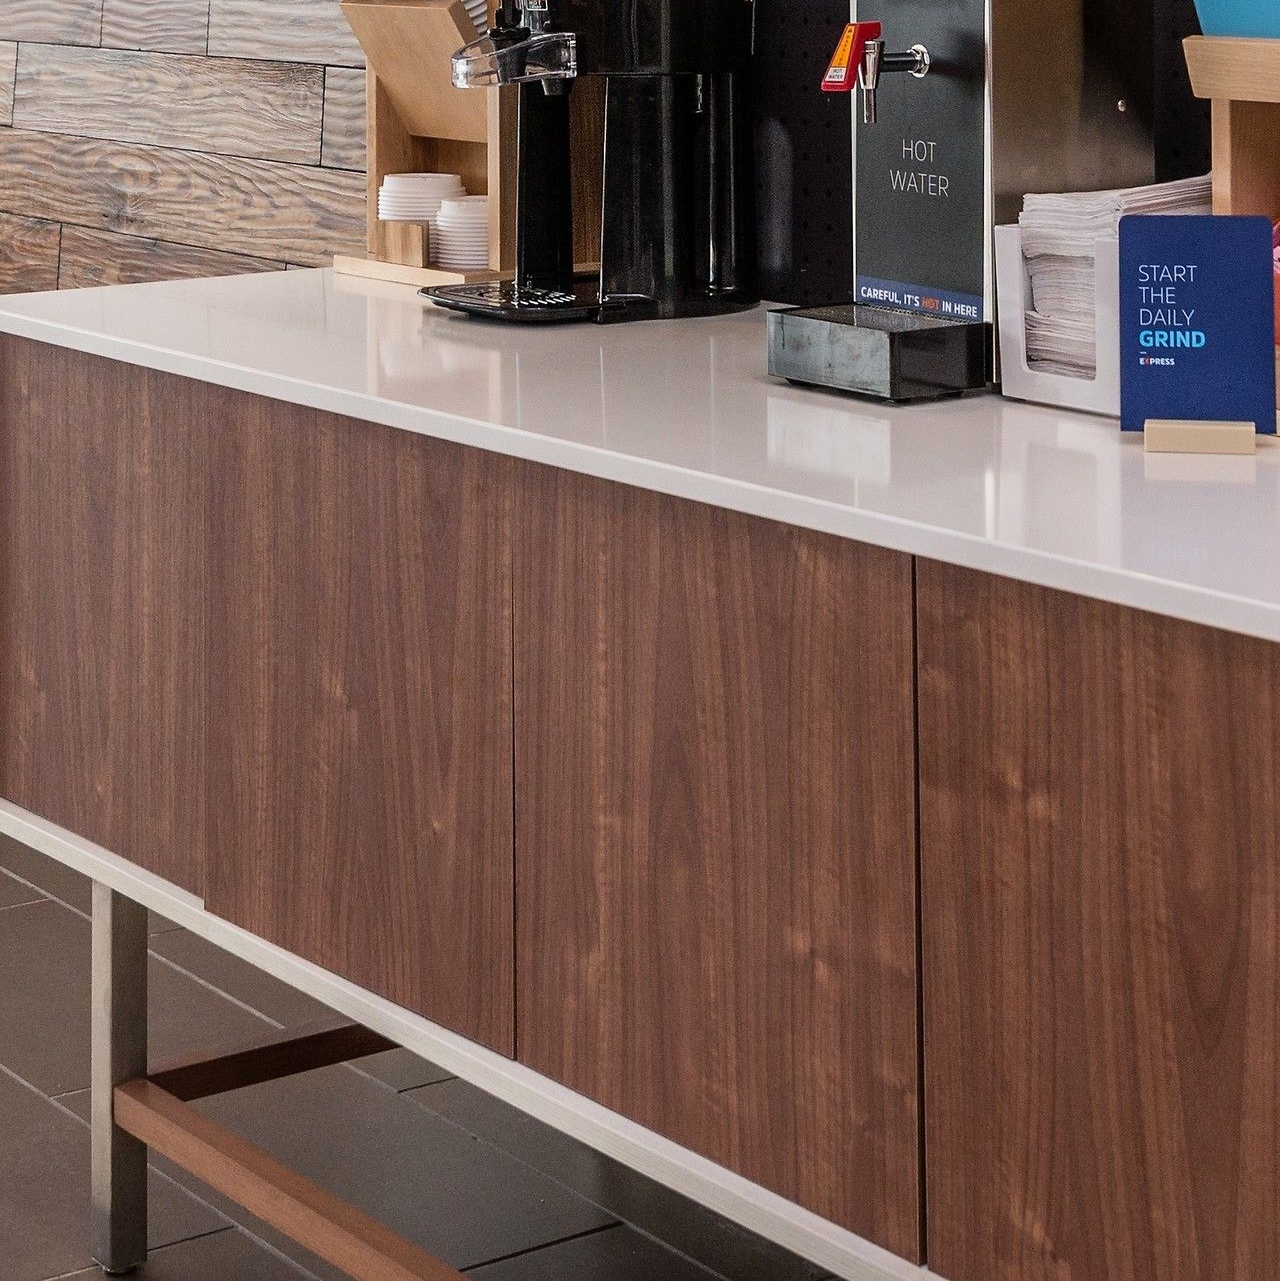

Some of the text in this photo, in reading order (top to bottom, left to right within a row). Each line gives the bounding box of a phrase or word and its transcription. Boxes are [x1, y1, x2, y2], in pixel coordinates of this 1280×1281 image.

[902, 138, 936, 163] HOT
[889, 169, 949, 197] WATER
[1138, 264, 1198, 282] START
[860, 286, 978, 318] CAREFUL, IT'S HOT IN HERE
[1138, 287, 1176, 304] THE
[1139, 308, 1195, 326] DAILY
[1139, 330, 1206, 348] GRIND
[1139, 357, 1176, 366] EXPRESS
